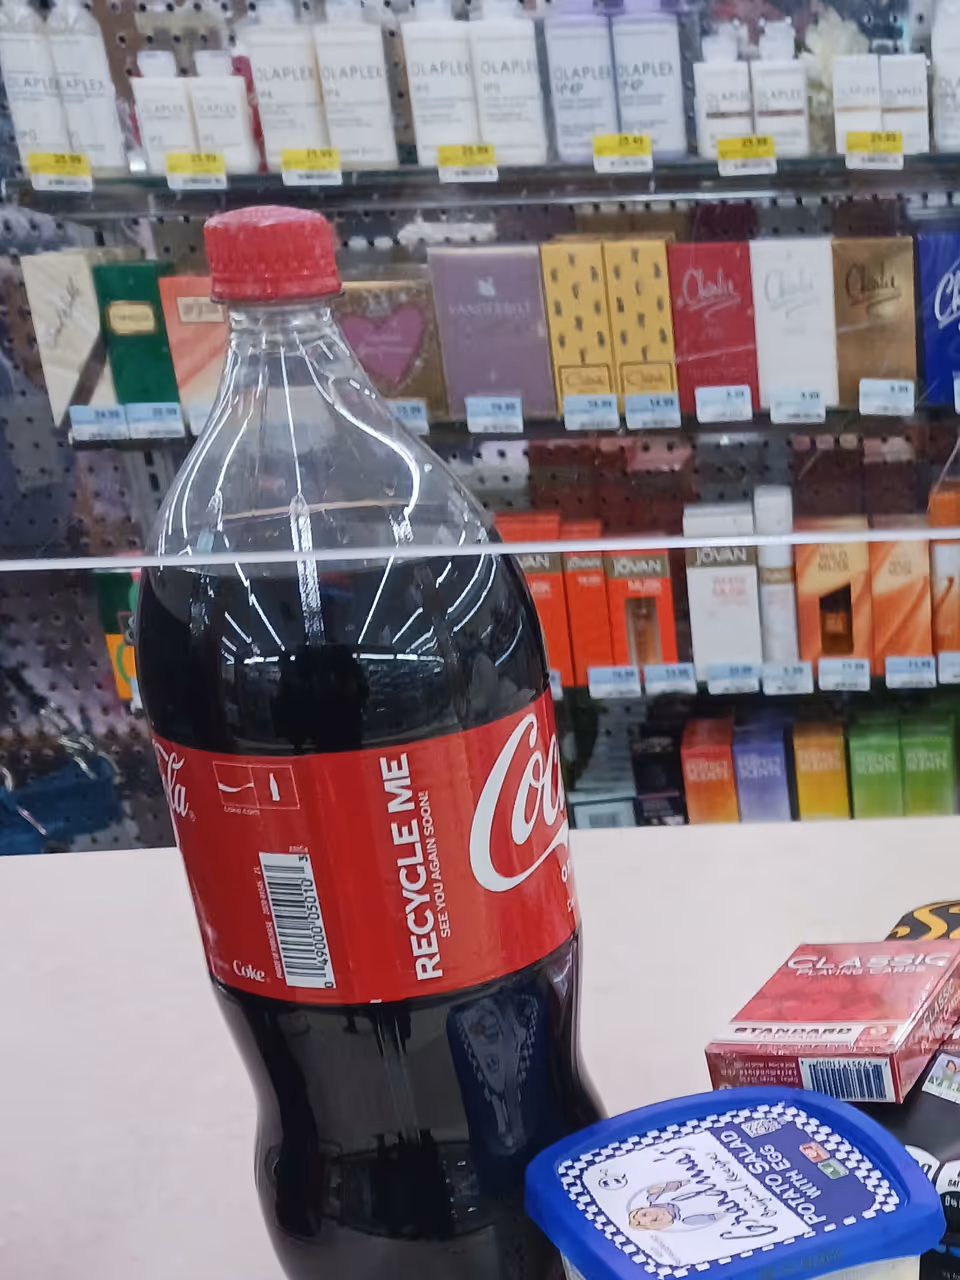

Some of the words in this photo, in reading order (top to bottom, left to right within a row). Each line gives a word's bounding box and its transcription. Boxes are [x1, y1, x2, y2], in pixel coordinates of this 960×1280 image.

[613, 558, 662, 575] JOVAN
[695, 546, 748, 564] JOVAN
[380, 753, 415, 814] ME
[418, 790, 435, 837] SOON!
[427, 837, 442, 881] AGAIN
[300, 879, 321, 921] 05010
[391, 818, 443, 980] RECYCLE
[433, 883, 445, 911] YOU
[439, 911, 451, 938] SEE
[232, 960, 265, 983] Coke
[787, 953, 952, 970] CLASSIC
[734, 1027, 852, 1036] STANDARD
[720, 1129, 770, 1175] SALAD
[759, 1144, 792, 1172] EGG
[652, 1147, 778, 1240] Grandma's
[764, 1173, 827, 1226] POTATO
[785, 1169, 822, 1200] WITH
